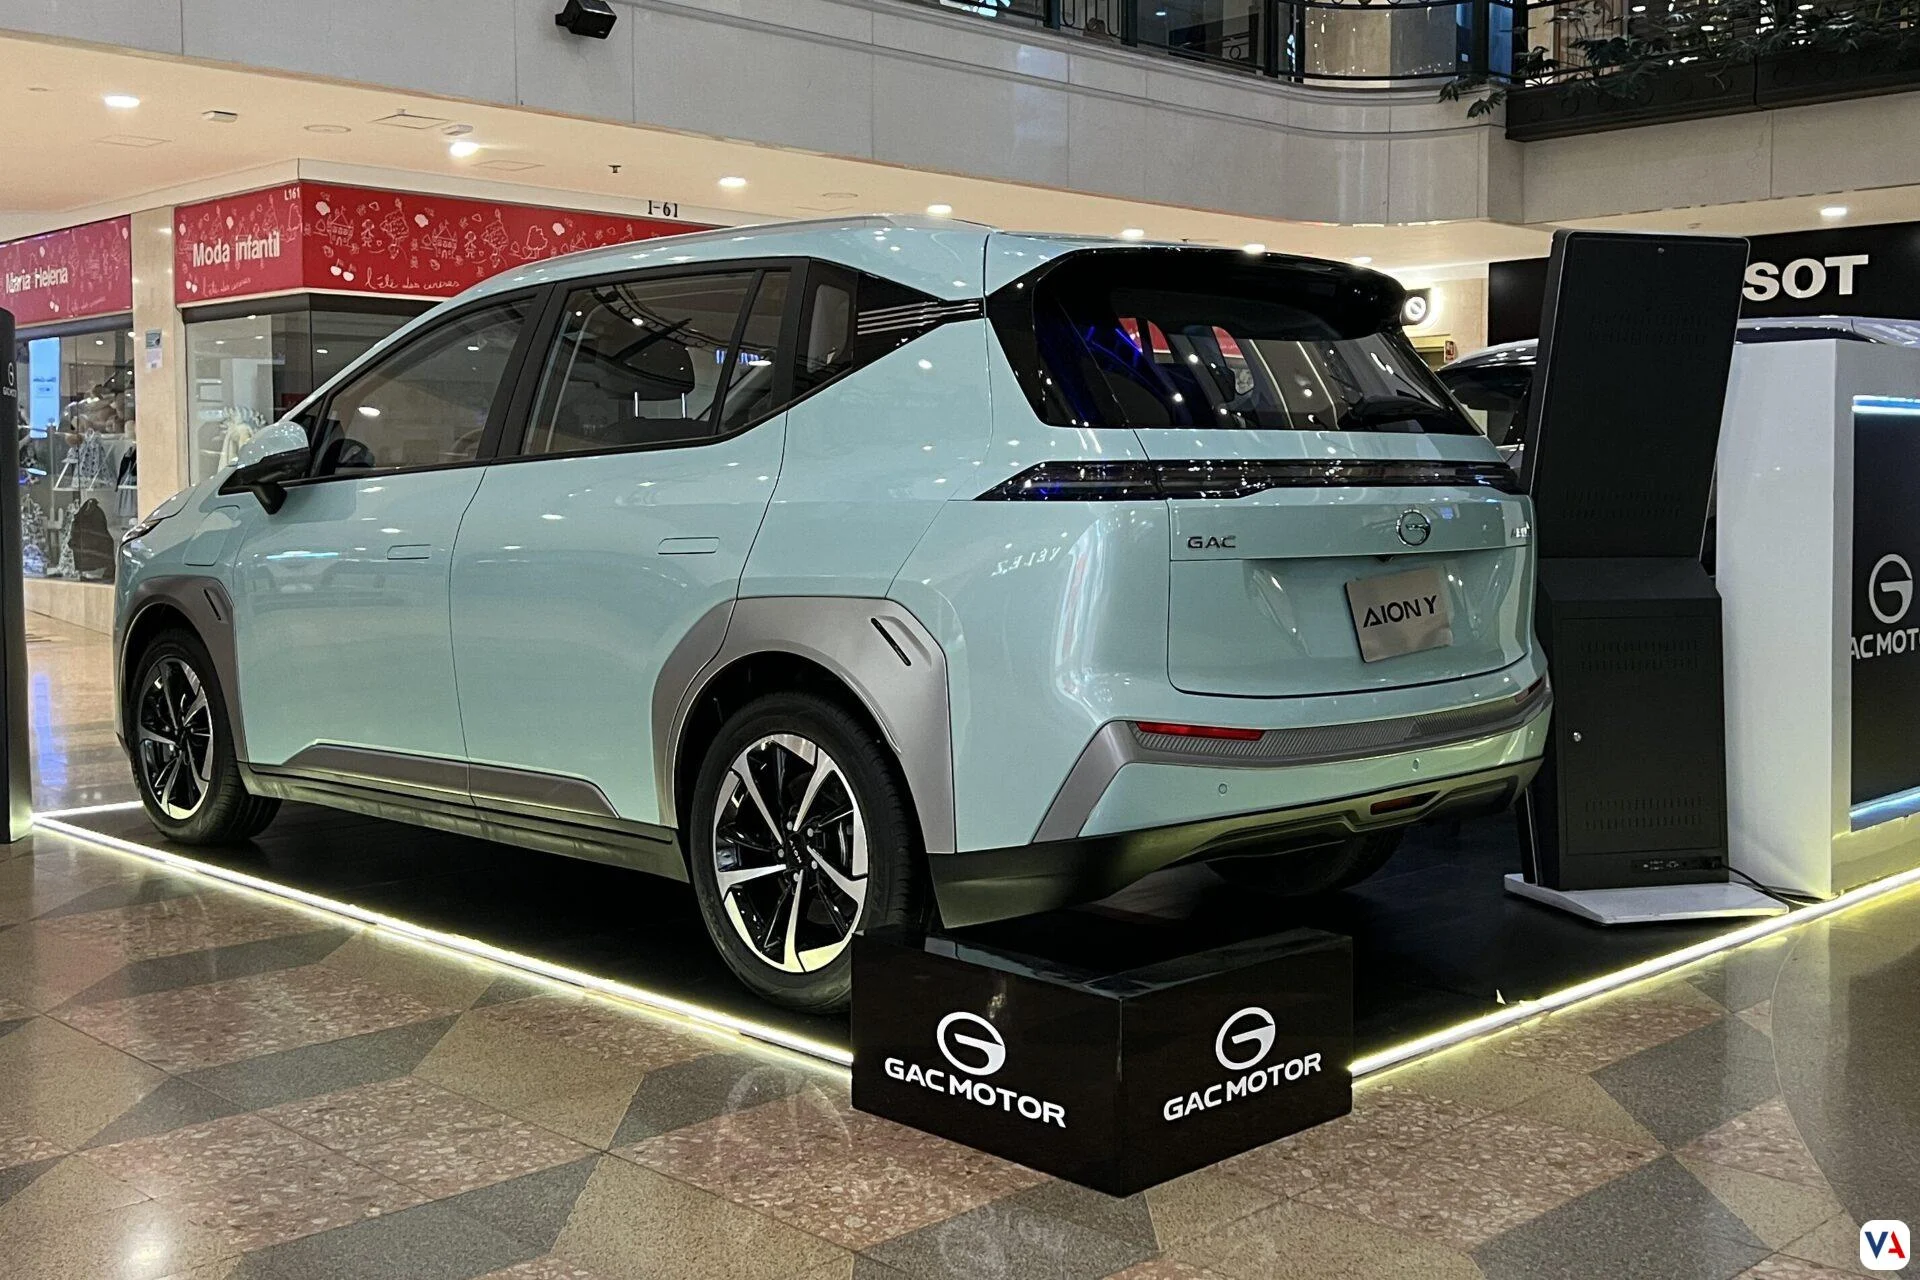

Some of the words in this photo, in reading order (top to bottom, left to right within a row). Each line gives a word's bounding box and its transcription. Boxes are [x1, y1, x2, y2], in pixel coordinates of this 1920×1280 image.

[193, 238, 230, 268] Moda
[235, 230, 280, 262] infantil
[34, 265, 69, 290] Helena
[1742, 254, 1869, 301] SOT
[1186, 535, 1236, 549] GAC
[1363, 598, 1422, 628] AION
[1423, 594, 1437, 615] Y
[1876, 627, 1920, 656] MOT
[884, 1056, 945, 1093] GAC
[949, 1073, 1067, 1129] MOTOR
[1163, 1083, 1222, 1122] GAC
[1225, 1051, 1322, 1102] MOTOR
